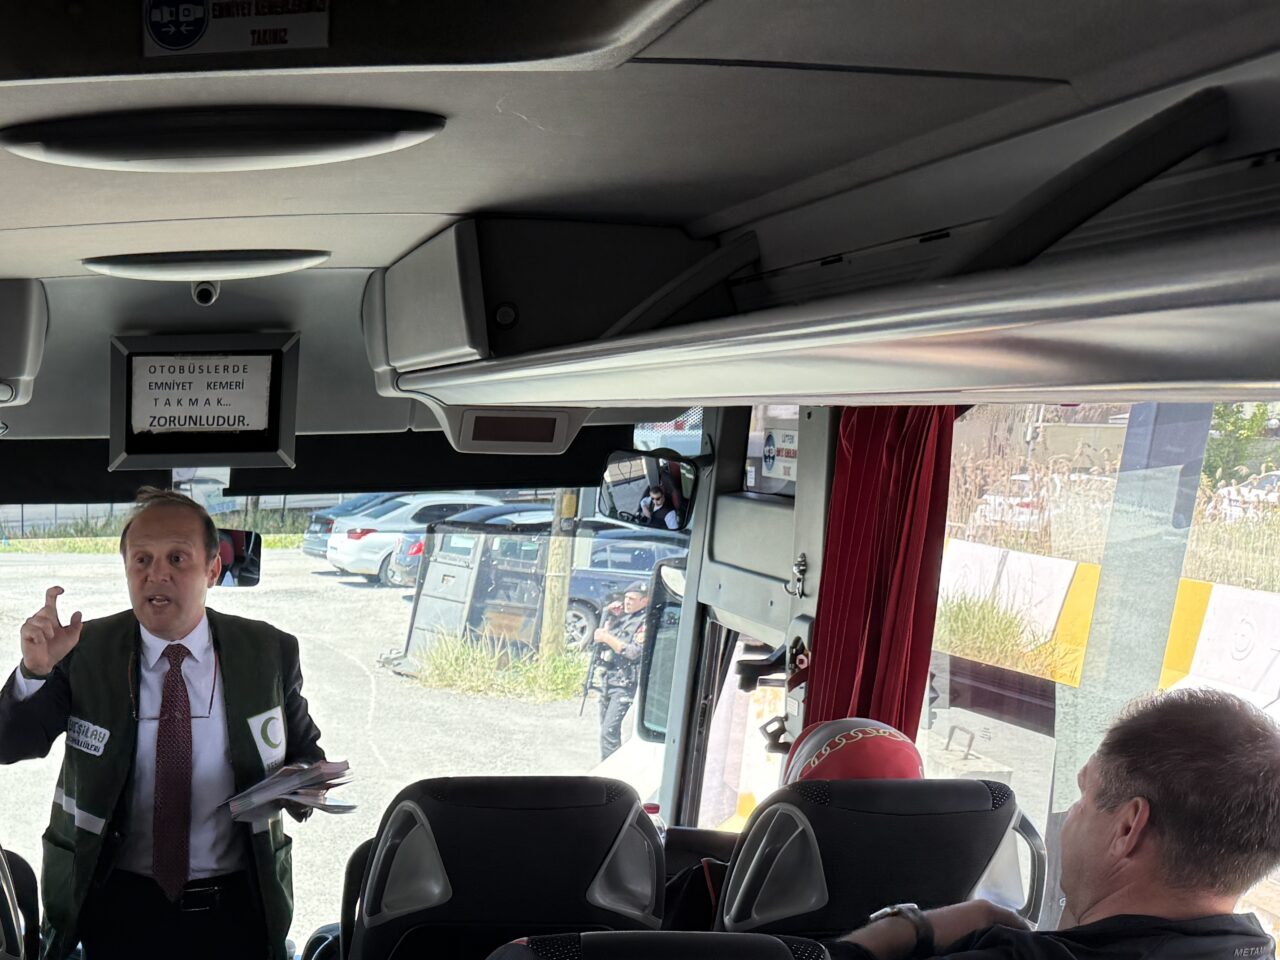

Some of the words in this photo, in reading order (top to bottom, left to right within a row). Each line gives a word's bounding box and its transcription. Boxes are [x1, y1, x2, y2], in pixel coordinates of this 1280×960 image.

[148, 363, 249, 375] OTOBÜSLERDE
[148, 379, 193, 391] EMNİYET
[206, 378, 245, 391] KEMERİ
[149, 415, 250, 428] ZORUNLUDUR.
